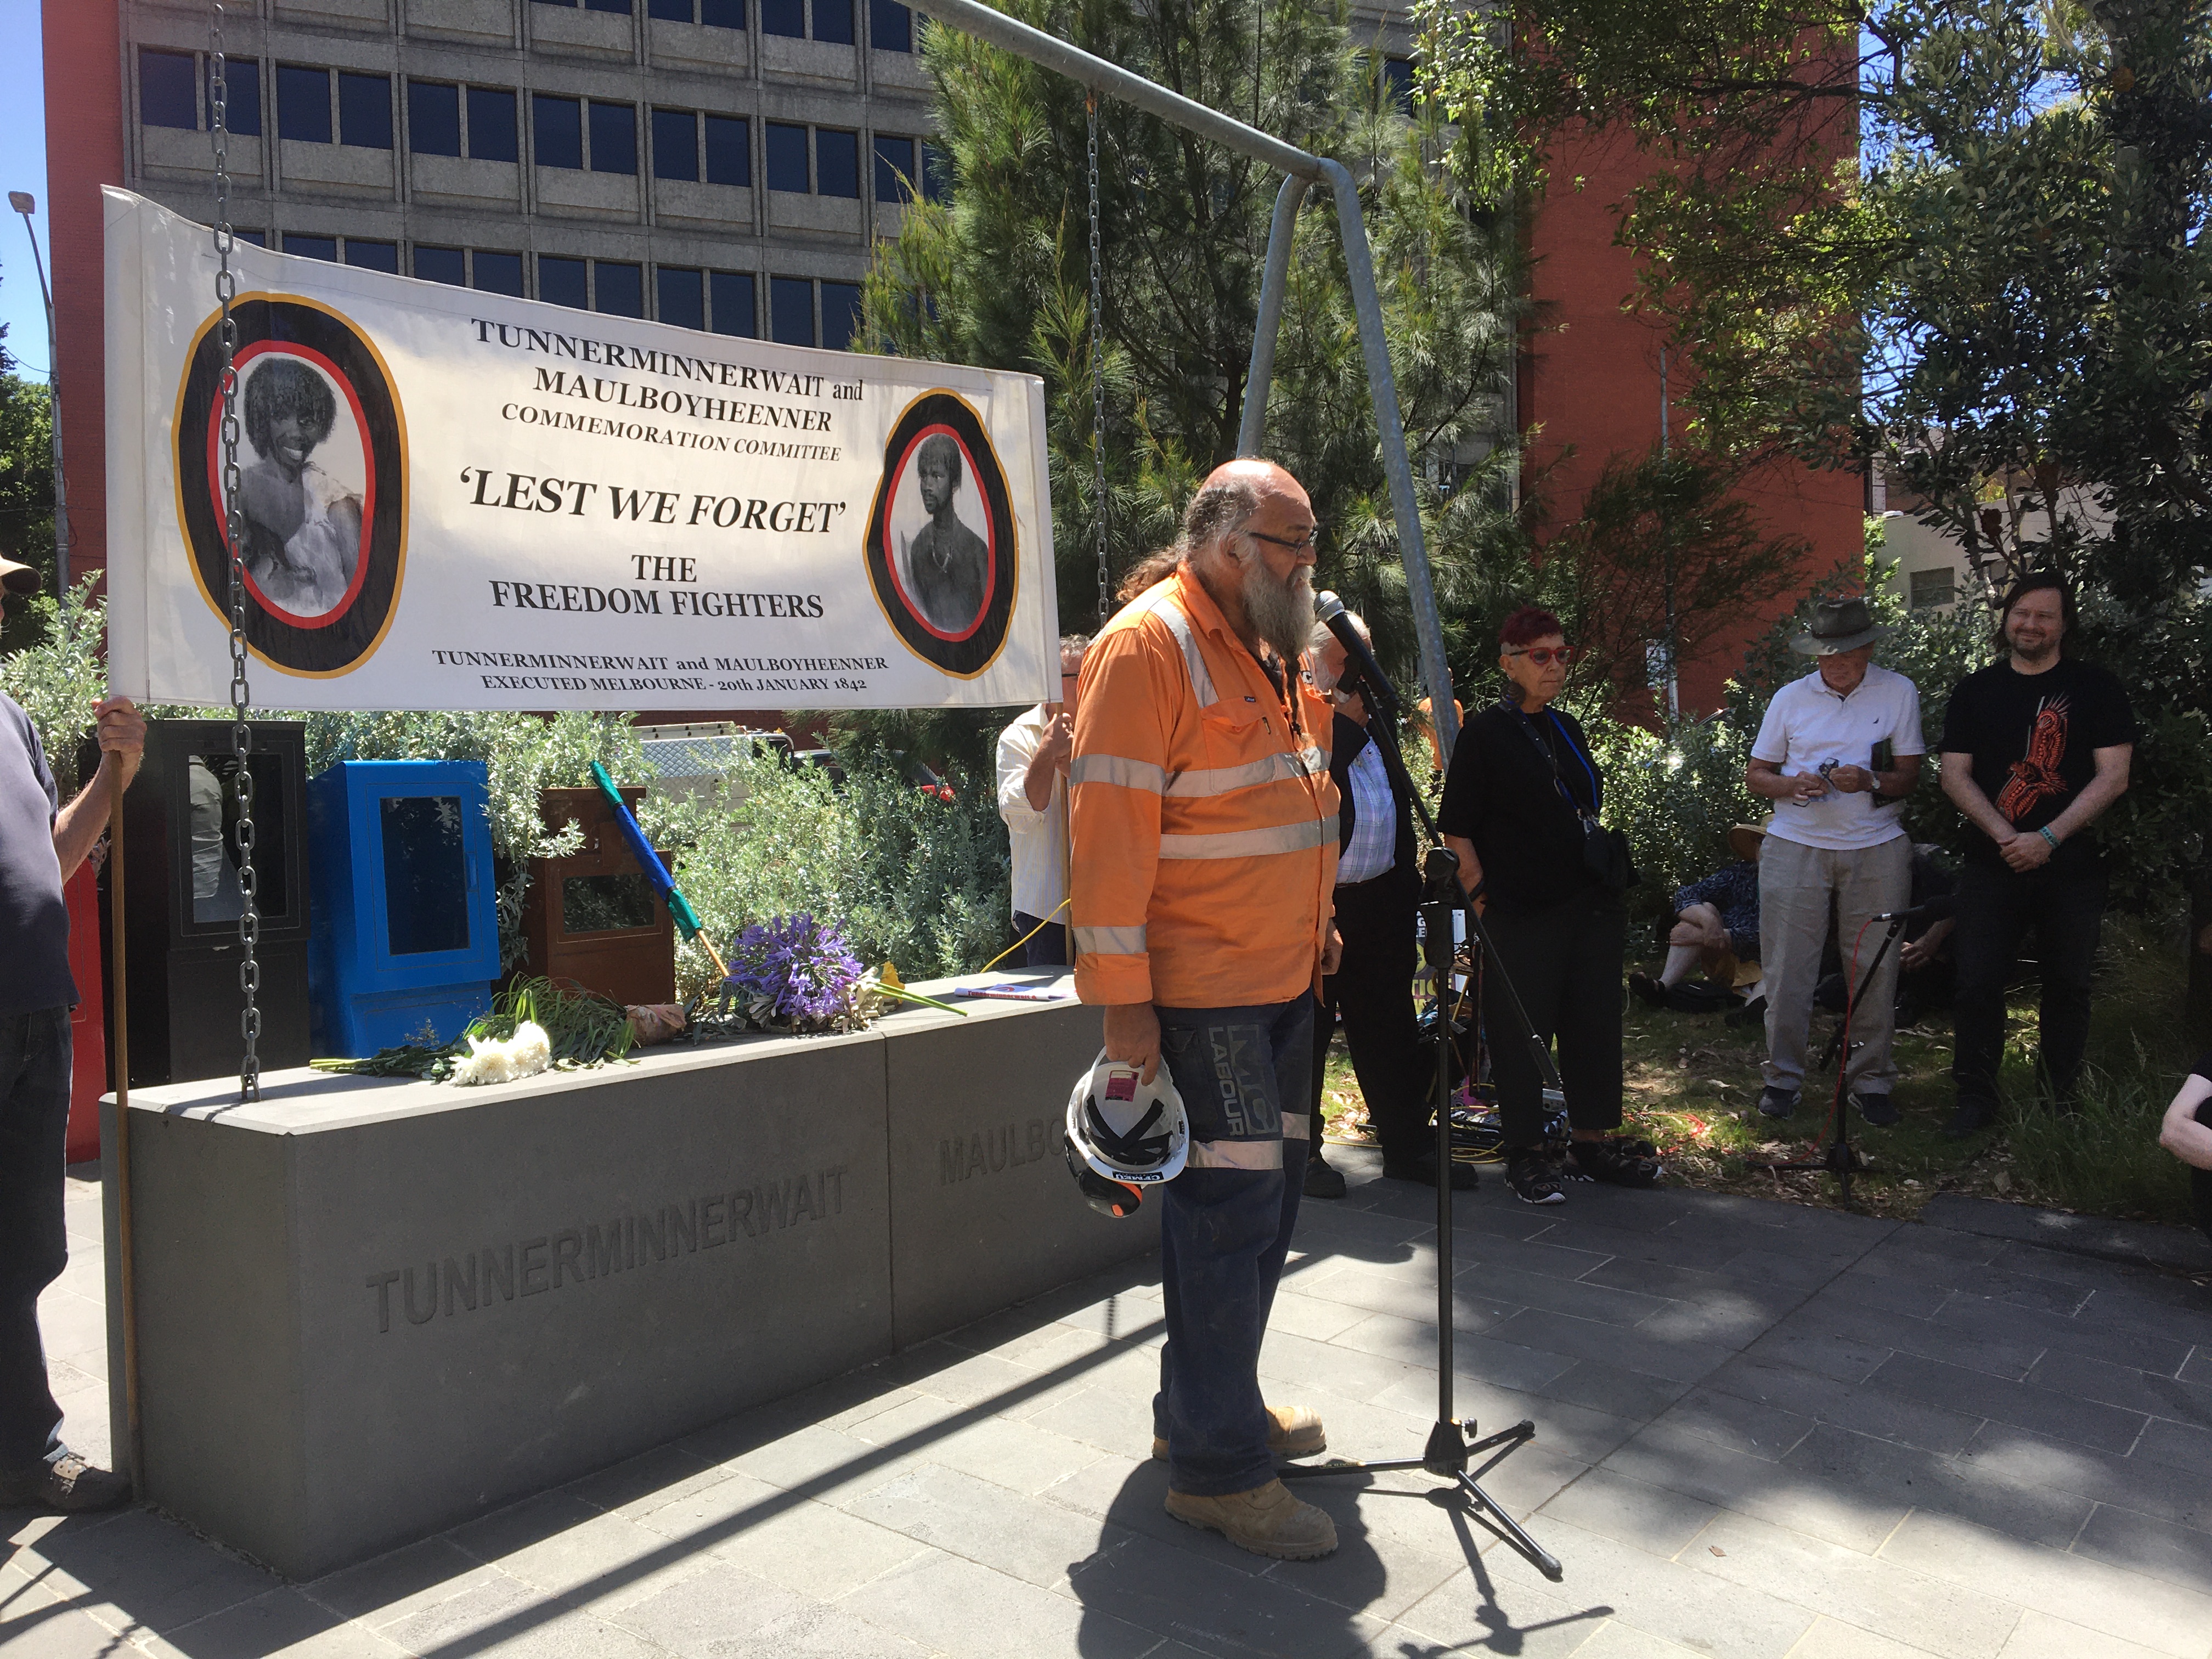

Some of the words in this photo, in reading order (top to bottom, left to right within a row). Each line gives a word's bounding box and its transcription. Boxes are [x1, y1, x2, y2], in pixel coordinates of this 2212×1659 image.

[471, 318, 824, 397] TUNNERMINNERWAIT
[832, 379, 864, 400] and
[532, 366, 832, 432] MAULBOYHEENNER
[501, 403, 731, 452] COMMEMORATION
[733, 438, 842, 461] COMMITTEE
[607, 486, 681, 524] WE
[631, 554, 697, 583] THE
[488, 580, 663, 615] FREEDOM
[669, 591, 824, 618] FIGHTERS
[432, 650, 668, 670] TUNNERMINNERWAIT
[676, 657, 710, 670] and
[713, 657, 890, 671] MAULBOYHEENNER
[481, 675, 587, 691] EXECUTED
[589, 677, 707, 691] MELBOURNE
[718, 678, 754, 691] 20th
[756, 678, 830, 691] JANUARY
[833, 677, 867, 692] 1842
[1209, 1026, 1244, 1136] LABOUR
[365, 1165, 848, 1334] TUNNERMINNERWAIT
